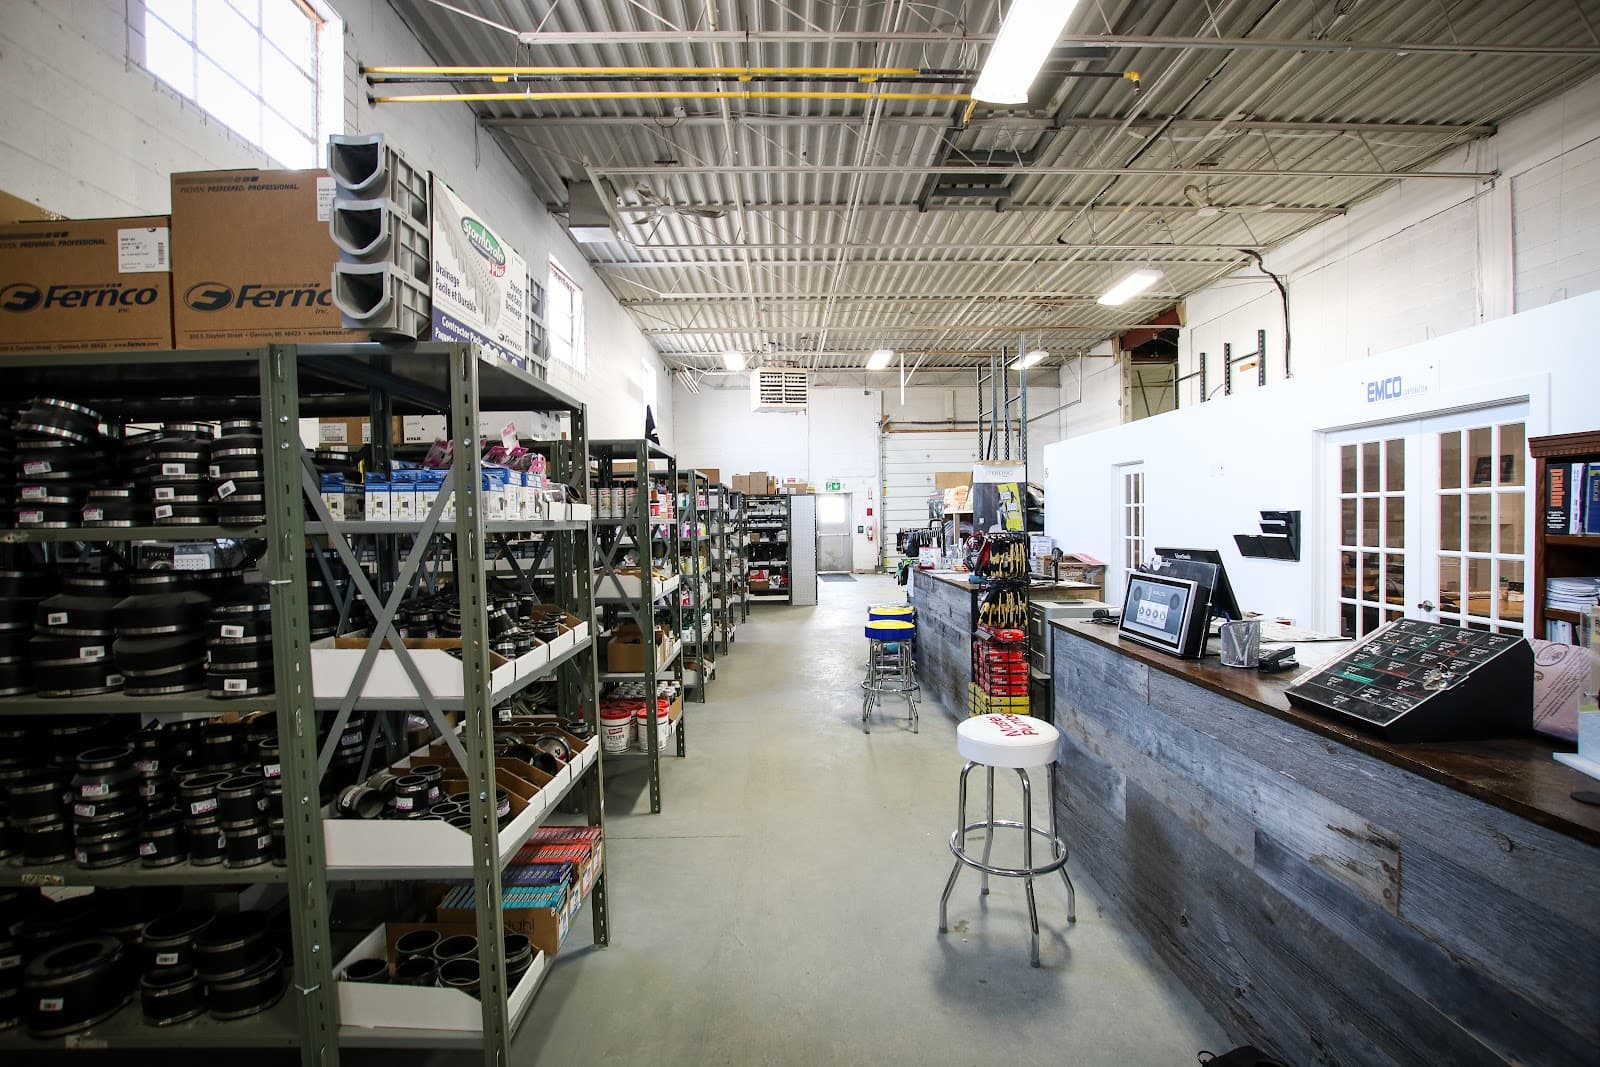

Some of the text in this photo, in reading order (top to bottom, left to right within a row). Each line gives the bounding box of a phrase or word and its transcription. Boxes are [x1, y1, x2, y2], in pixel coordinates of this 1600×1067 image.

[248, 183, 300, 191] PROFESSIONAL.
[59, 238, 107, 247] PROFESSIONAL.
[435, 260, 459, 287] Drainage
[43, 284, 159, 309] Fernco
[235, 284, 332, 309] Fernc
[435, 277, 477, 314] Facile et Durable
[441, 315, 470, 340] Contractor
[504, 334, 522, 351] Fernco
[1367, 375, 1402, 402] EMCO
